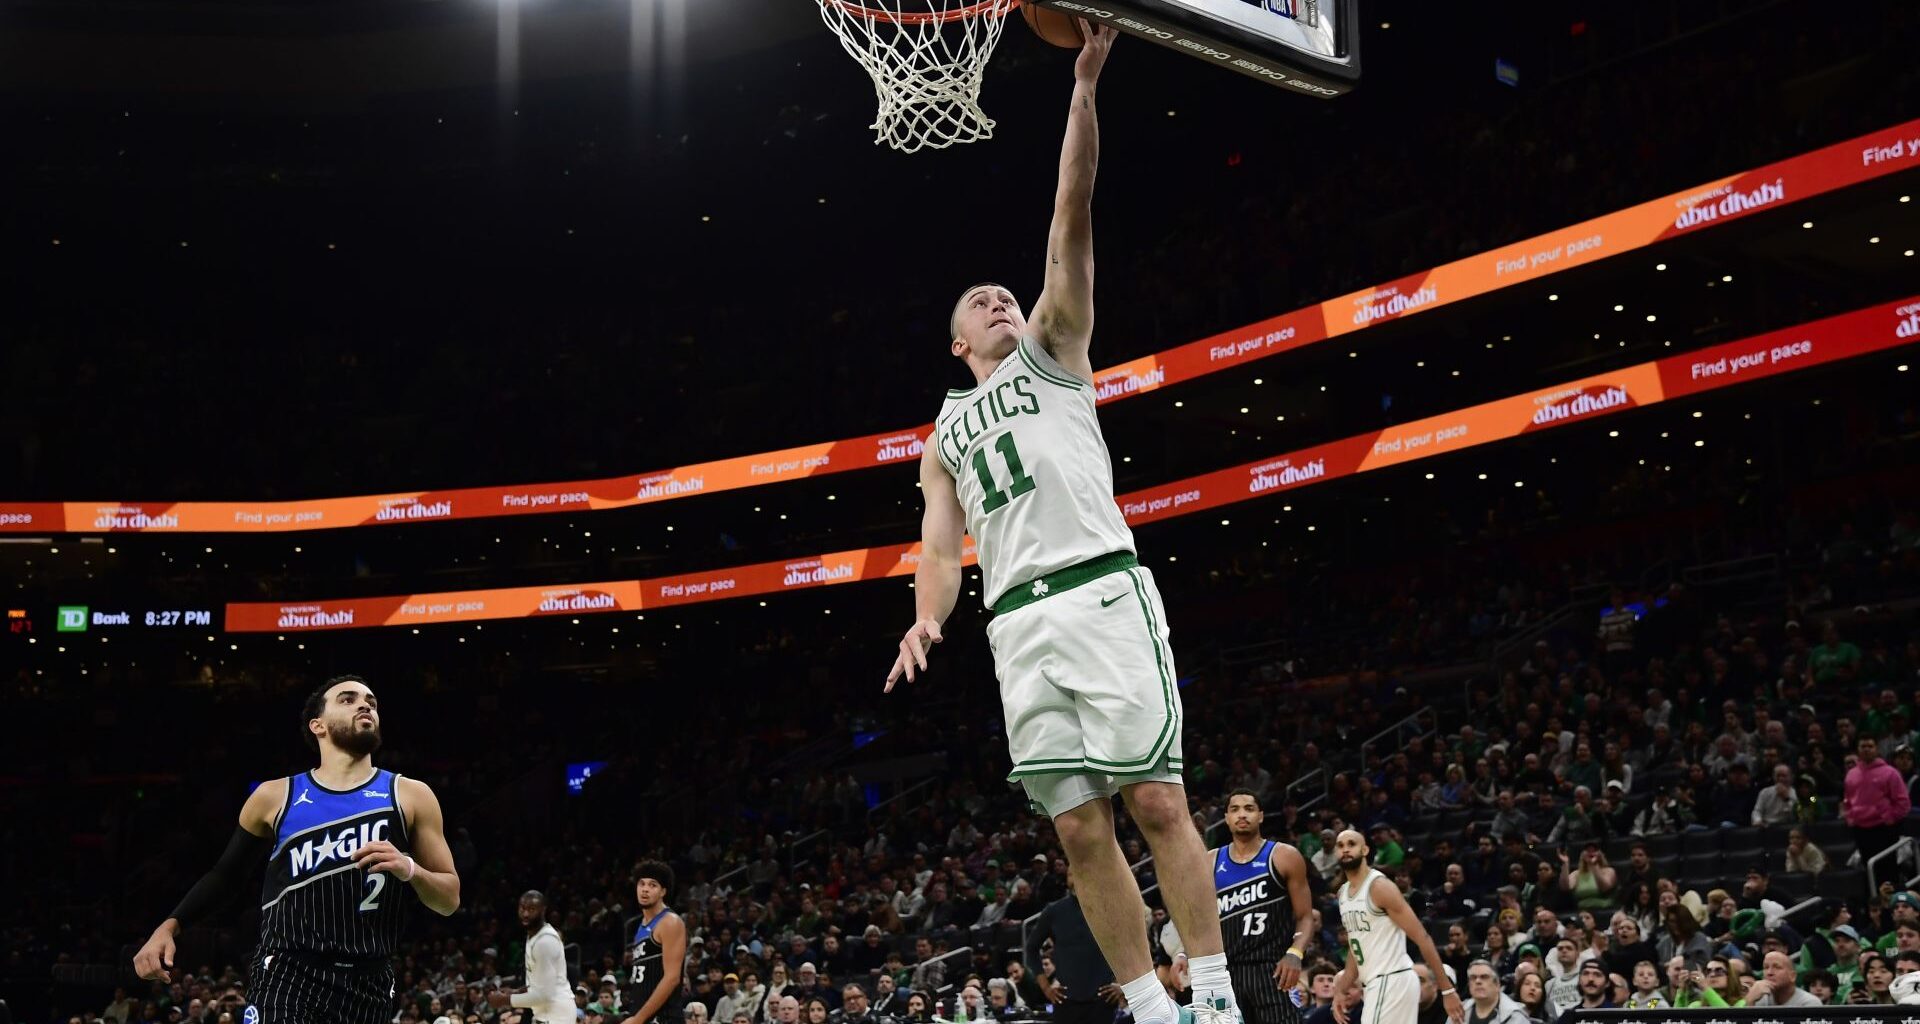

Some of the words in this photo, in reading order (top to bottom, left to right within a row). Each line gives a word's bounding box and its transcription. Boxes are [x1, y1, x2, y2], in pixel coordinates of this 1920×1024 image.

[1862, 140, 1904, 166] Find
[1675, 203, 1717, 229] abu
[1719, 177, 1784, 216] dhabi
[1496, 255, 1527, 275] Find
[1530, 246, 1562, 269] your
[1566, 234, 1603, 257] pace
[1353, 303, 1386, 324] abu
[1386, 283, 1437, 314] dhabi
[1896, 314, 1920, 338] ab
[1210, 343, 1236, 361] Find
[1237, 336, 1263, 355] your
[1266, 327, 1295, 346] pace
[1691, 358, 1726, 379] Find
[1729, 351, 1767, 374] your
[1771, 340, 1812, 364] pace
[1095, 380, 1123, 400] abu
[1123, 365, 1164, 392] dhabi
[1533, 405, 1569, 424] abu
[1571, 385, 1628, 416] dhabi
[941, 375, 1041, 473] CELTICS
[1373, 437, 1402, 455] Find
[1404, 432, 1432, 450] your
[1436, 424, 1468, 443] pace
[751, 463, 775, 475] Find
[776, 460, 801, 473] your
[803, 455, 830, 469] pace
[877, 446, 906, 461] abu
[972, 431, 1036, 515] 11
[1250, 474, 1278, 492] abu
[1280, 458, 1325, 484] dhabi
[503, 495, 529, 506] Find
[531, 495, 558, 507] your
[560, 492, 589, 504] pace
[637, 484, 663, 499] abu
[665, 476, 704, 497] dhabi
[376, 504, 405, 520] abu
[407, 501, 451, 518] dhabi
[1123, 501, 1147, 516] Find
[1149, 497, 1173, 513] your
[1174, 489, 1200, 507] pace
[0, 513, 32, 525] pace
[94, 514, 128, 528] abu
[129, 513, 178, 528] dhabi
[235, 512, 262, 523] Find
[266, 514, 291, 525] your
[295, 511, 323, 522] pace
[784, 570, 811, 586] abu
[812, 563, 853, 582] dhabi
[661, 586, 683, 597] Find
[685, 584, 708, 596] your
[710, 579, 735, 593] pace
[401, 604, 426, 615] Find
[428, 604, 452, 616] your
[456, 601, 484, 612] pace
[539, 597, 569, 611] abu
[571, 593, 614, 610] dhabi
[61, 610, 85, 627] TD
[93, 611, 130, 625] Bank
[145, 611, 181, 626] 8:27
[185, 611, 211, 625] PM
[278, 613, 309, 627] abu
[310, 609, 353, 626] dhabi
[360, 873, 386, 912] 2
[1242, 912, 1268, 936] 13
[1350, 938, 1365, 967] 9
